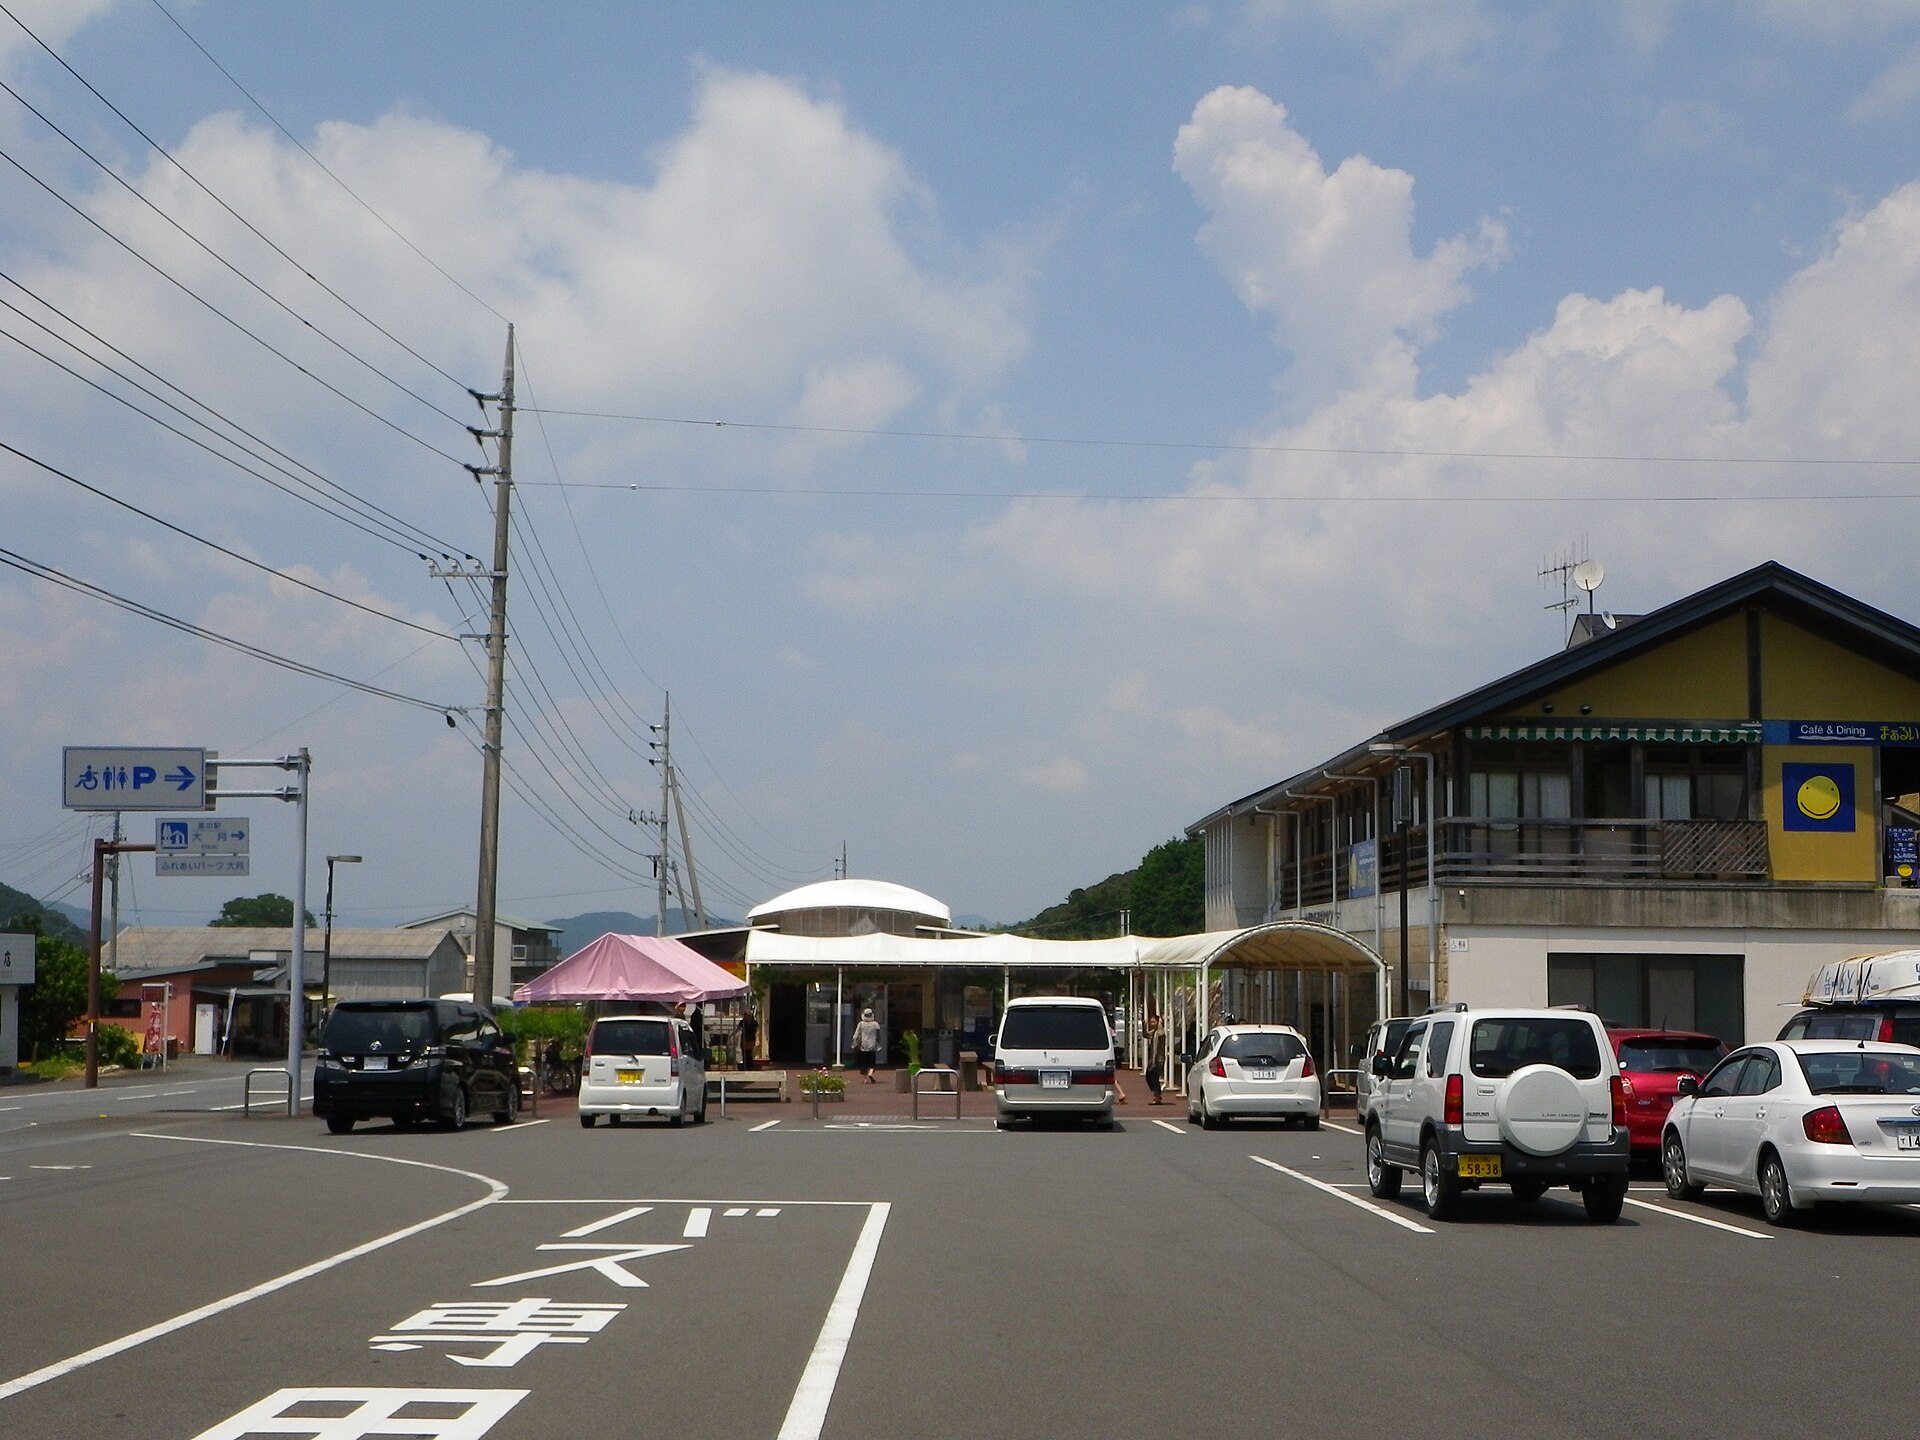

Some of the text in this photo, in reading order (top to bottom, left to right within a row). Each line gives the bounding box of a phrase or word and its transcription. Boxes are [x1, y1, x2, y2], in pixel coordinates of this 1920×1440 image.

[1800, 724, 1866, 737] Café & Dining
[133, 766, 156, 789] P
[1467, 1163, 1499, 1175] 58-38
